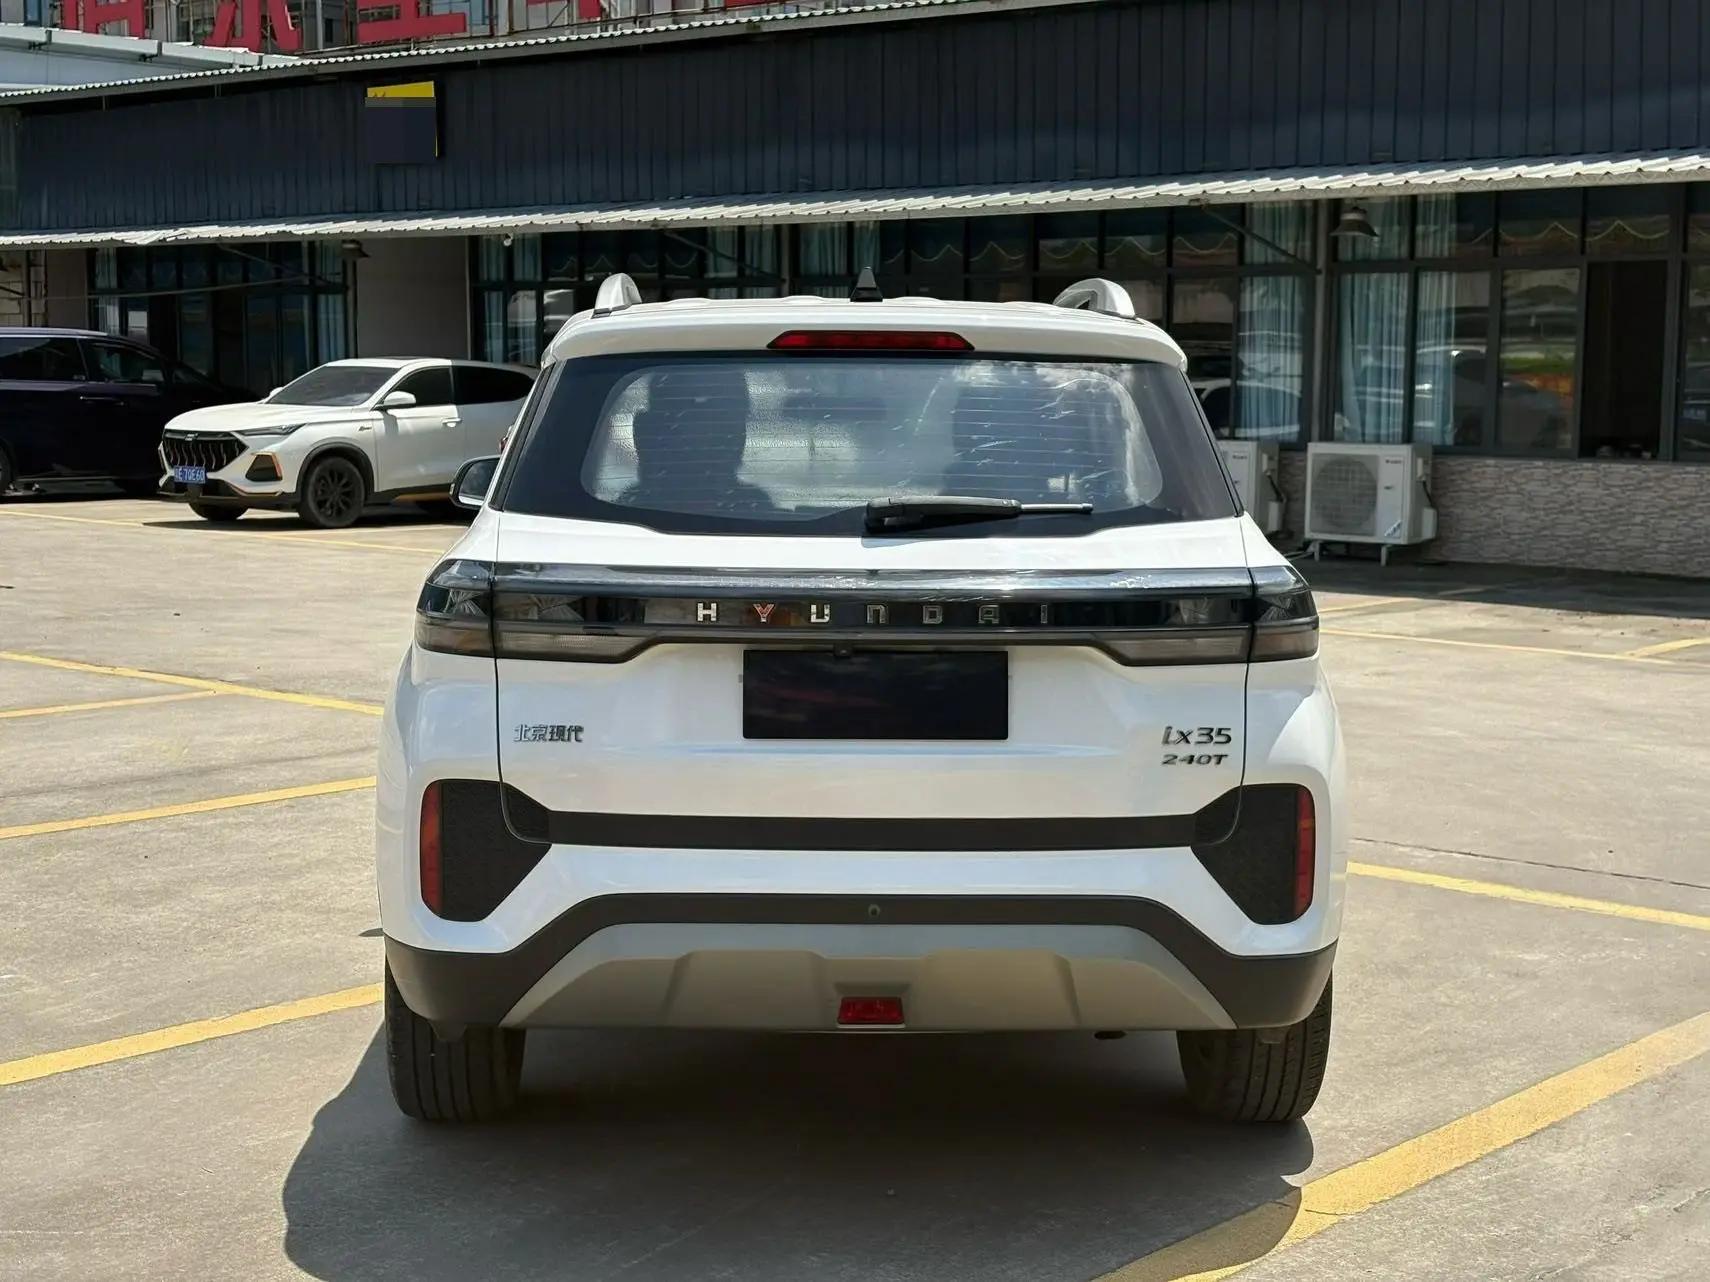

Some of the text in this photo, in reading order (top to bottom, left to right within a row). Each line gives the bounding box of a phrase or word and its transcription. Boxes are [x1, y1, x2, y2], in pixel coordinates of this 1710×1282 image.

[697, 603, 1048, 624] HYUNDAI
[513, 724, 584, 742] 北京现代
[1161, 726, 1232, 745] ix35
[1162, 754, 1229, 766] 240T
